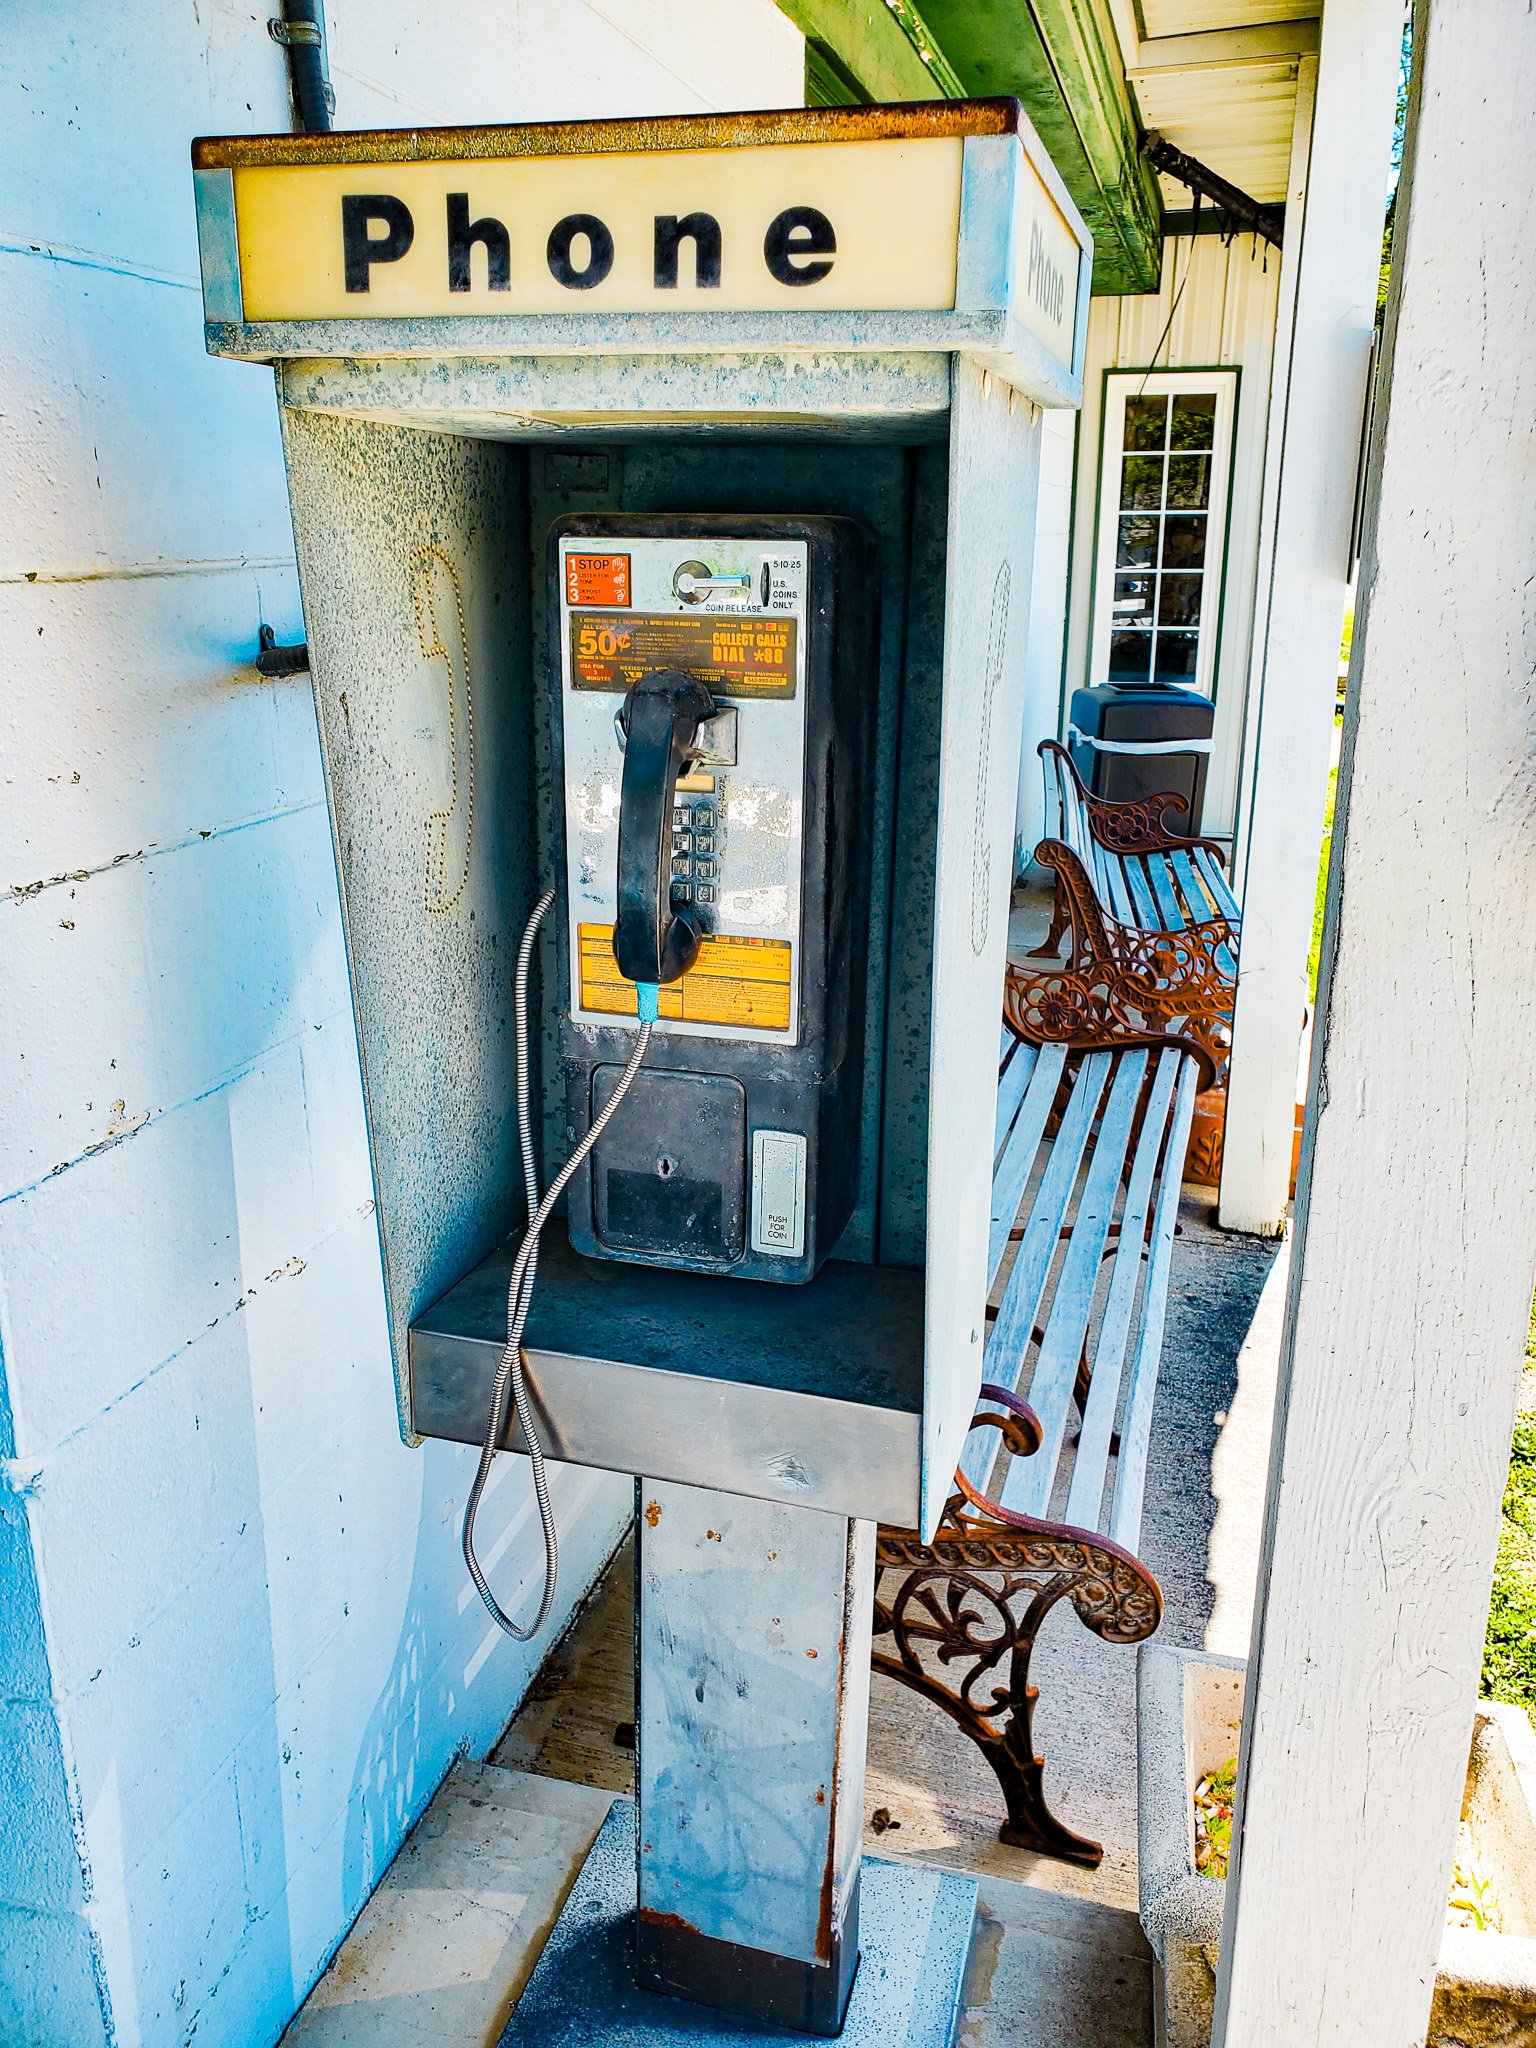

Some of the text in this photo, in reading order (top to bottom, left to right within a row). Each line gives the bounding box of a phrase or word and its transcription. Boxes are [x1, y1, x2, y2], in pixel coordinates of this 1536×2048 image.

[341, 192, 838, 294] Phone
[1027, 218, 1064, 326] Phone
[569, 557, 610, 571] 1 STOP
[569, 572, 578, 587] 2
[772, 580, 788, 588] U.S.
[569, 588, 579, 602] 3
[772, 590, 798, 599] COINS
[705, 603, 762, 613] COIN RELEASE
[772, 601, 794, 609] ONLY
[712, 632, 755, 646] COLLECT
[756, 633, 787, 647] CALLS
[712, 646, 746, 663] DIAL
[768, 1214, 788, 1224] PUSH
[769, 1223, 785, 1231] FOR
[767, 1230, 788, 1240] COIN
